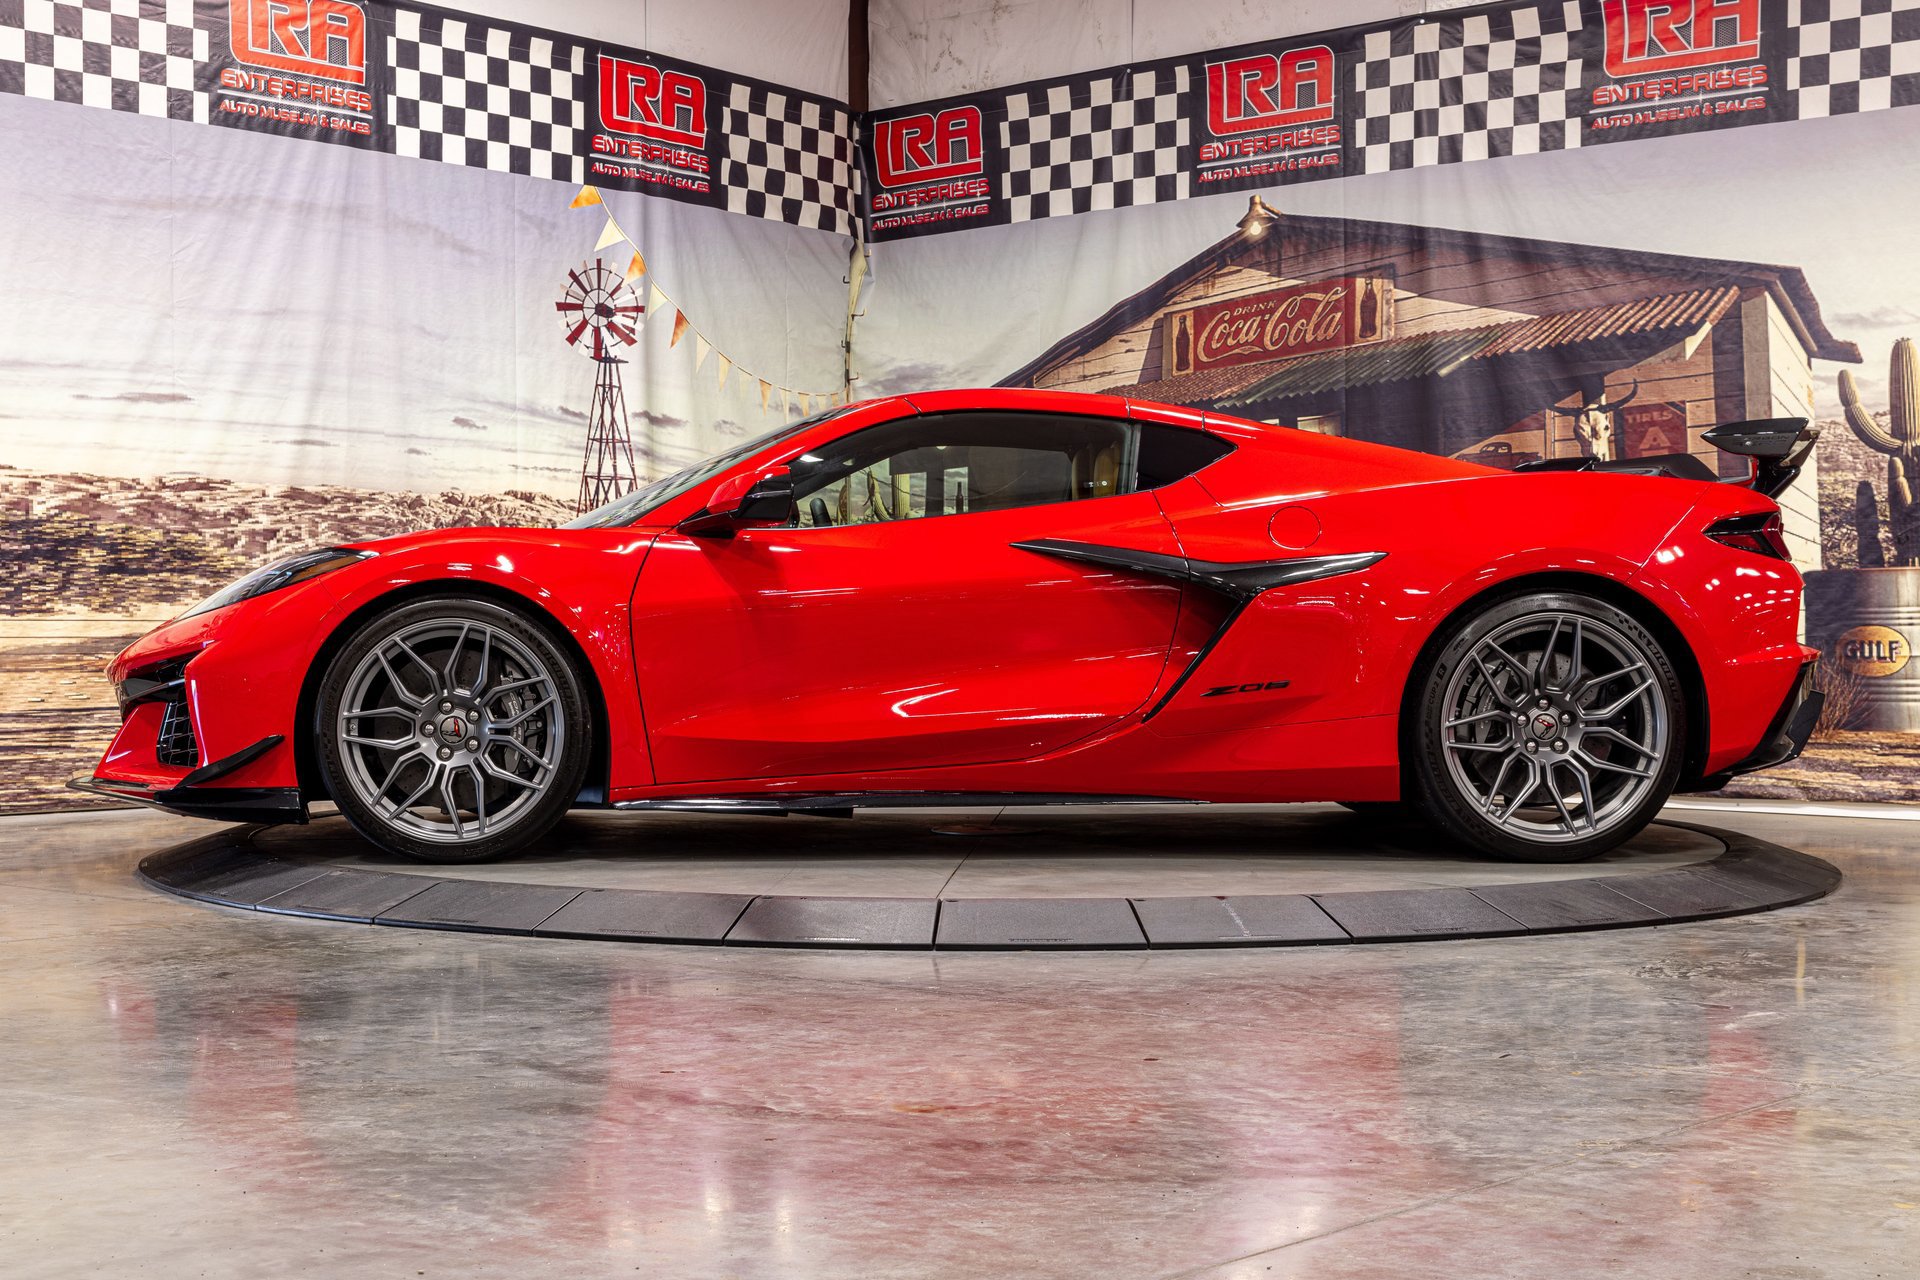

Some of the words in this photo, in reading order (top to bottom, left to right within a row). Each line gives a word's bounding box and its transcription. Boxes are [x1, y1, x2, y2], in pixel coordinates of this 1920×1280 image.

[220, 68, 372, 112] ENTERPRISES
[598, 54, 707, 150] LRA
[1205, 44, 1335, 136] LRA
[1592, 64, 1768, 105] ENTERPRISES
[219, 99, 259, 117] AUTO
[260, 105, 318, 127] MUSEUM
[319, 115, 329, 128] &
[330, 117, 371, 136] SALES
[1592, 115, 1632, 130] AUTO
[1634, 105, 1700, 125] MUSEUM
[1702, 102, 1713, 116] &
[1715, 96, 1766, 115] SALES
[591, 134, 710, 173] ENTERPRISES
[873, 104, 983, 188] LRA
[1200, 125, 1341, 161] ENTERPRISES
[591, 162, 621, 176] AUTO
[621, 166, 668, 185] MUSEUM
[675, 177, 710, 193] SALES
[1198, 168, 1233, 183] AUTO
[1234, 161, 1287, 178] MUSEUM
[1288, 159, 1297, 171] &
[1299, 153, 1339, 169] SALES
[872, 178, 990, 211] ENTERPRISES
[871, 219, 900, 231] AUTO
[901, 211, 946, 226] MUSEUM
[946, 209, 954, 220] &
[954, 204, 989, 218] SALES
[1196, 286, 1349, 363] Coca-Cola
[1233, 300, 1278, 316] DRINK
[1625, 410, 1673, 424] TIRES
[1844, 640, 1902, 663] GULF
